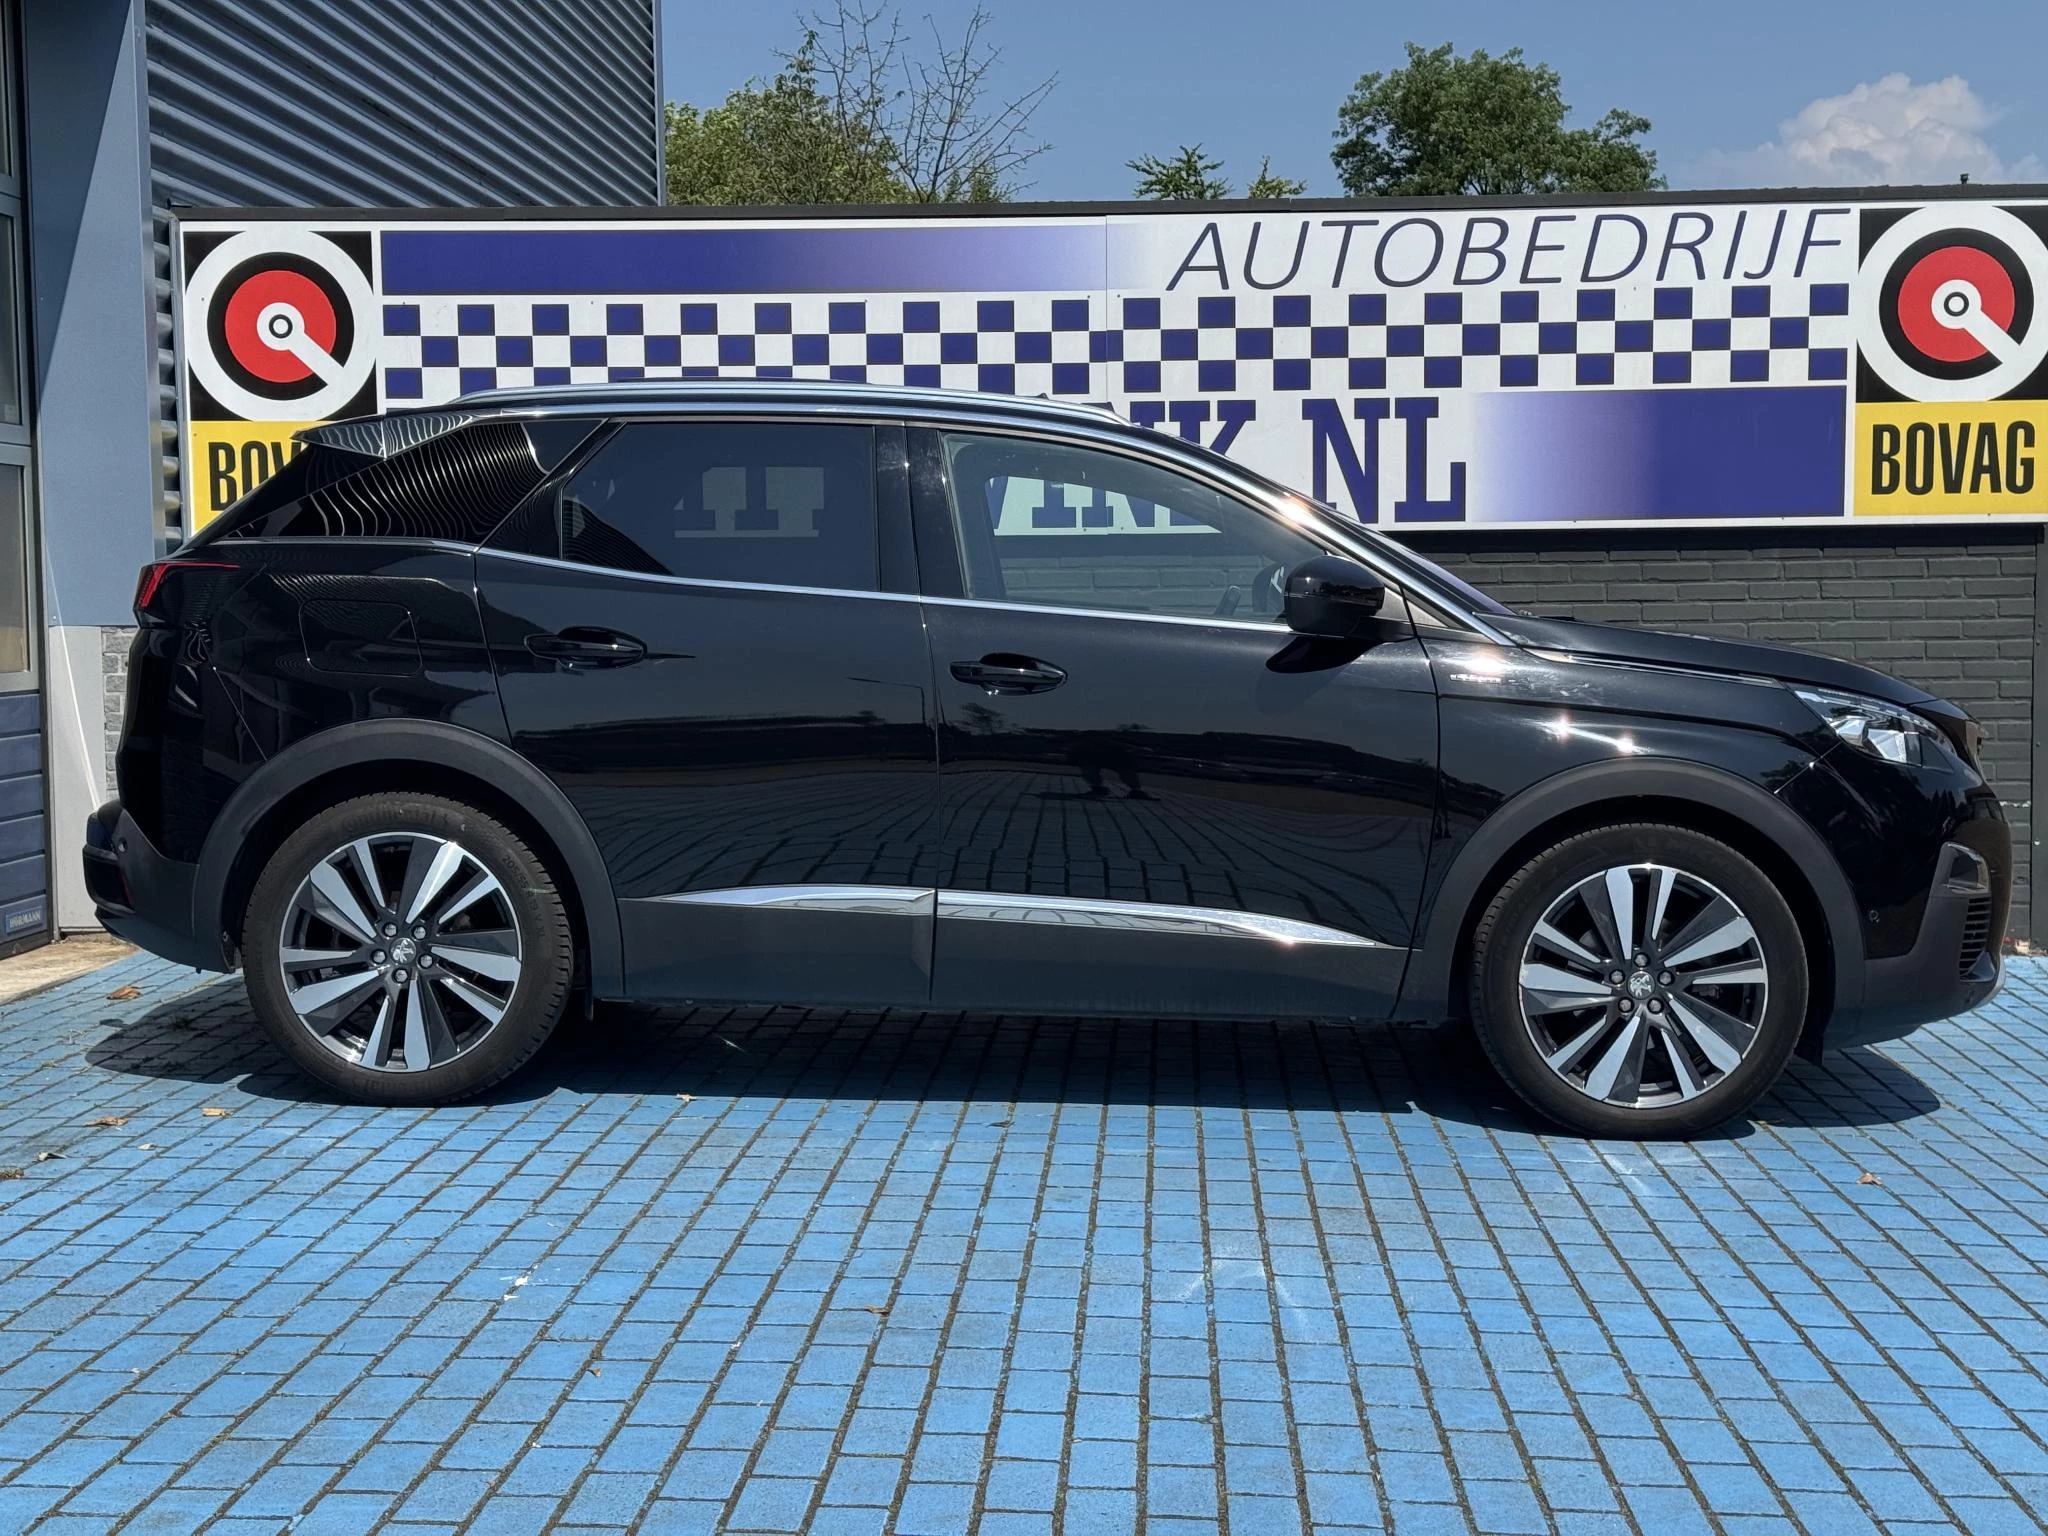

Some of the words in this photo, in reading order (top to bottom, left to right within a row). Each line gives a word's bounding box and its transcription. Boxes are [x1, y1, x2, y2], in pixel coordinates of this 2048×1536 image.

[1166, 208, 1851, 291] AUTOBEDRIJF
[1302, 397, 1466, 525] NL
[1871, 420, 2036, 496] BOVAG
